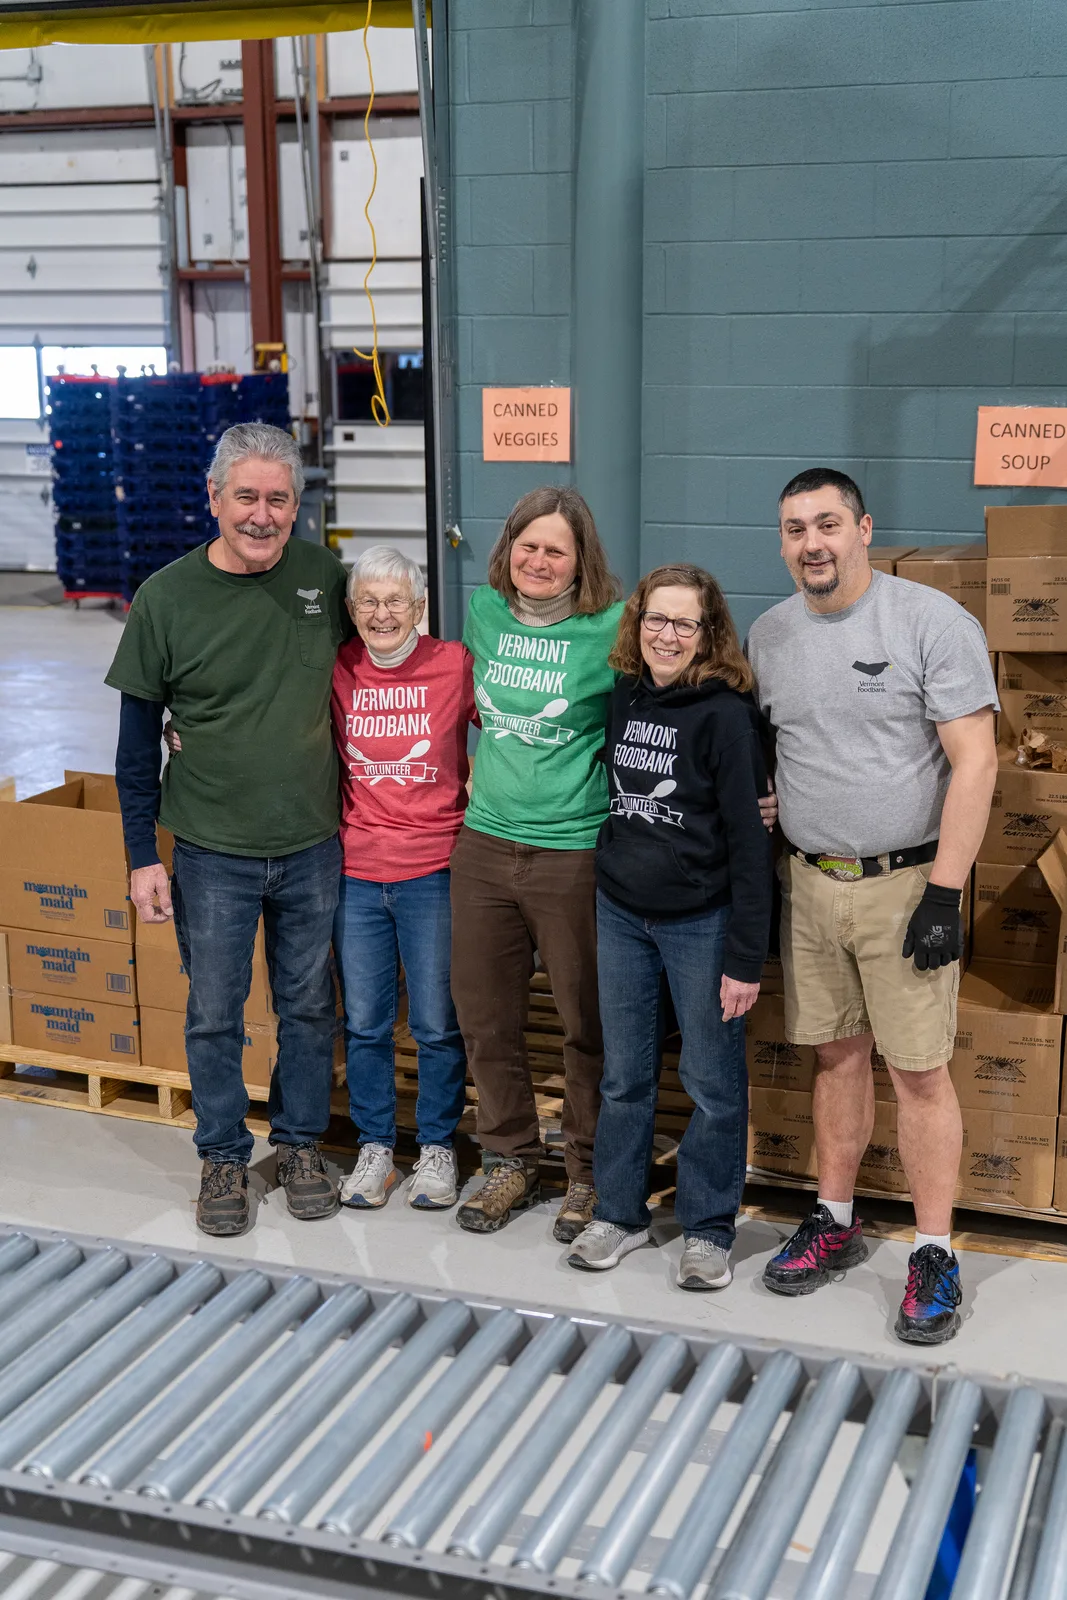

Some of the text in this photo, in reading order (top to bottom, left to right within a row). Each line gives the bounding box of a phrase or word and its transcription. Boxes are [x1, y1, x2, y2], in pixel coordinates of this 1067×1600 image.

[493, 403, 558, 417] CANNED
[493, 432, 558, 446] VEGGIES
[990, 422, 1066, 439] CANNED
[1001, 454, 1051, 470] SOUP
[497, 633, 571, 664] VERMONT
[484, 659, 568, 694] FOODBANK
[352, 686, 428, 711] VERMONT
[345, 713, 431, 738] FOODBANK
[491, 715, 541, 736] VOLUNTEER
[622, 720, 678, 750] VERMONT
[613, 743, 678, 776] FOODBANK
[364, 764, 411, 776] VOLUNTEER
[24, 881, 88, 899] mountain
[40, 896, 74, 910] maid
[26, 944, 91, 963] mountain
[42, 959, 77, 973] maid
[31, 1003, 95, 1023] mountain
[46, 1019, 80, 1033] maid
[995, 1056, 1026, 1064] VALLEY
[772, 1132, 800, 1141] VALLEY
[990, 1154, 1021, 1162] VALLEY
